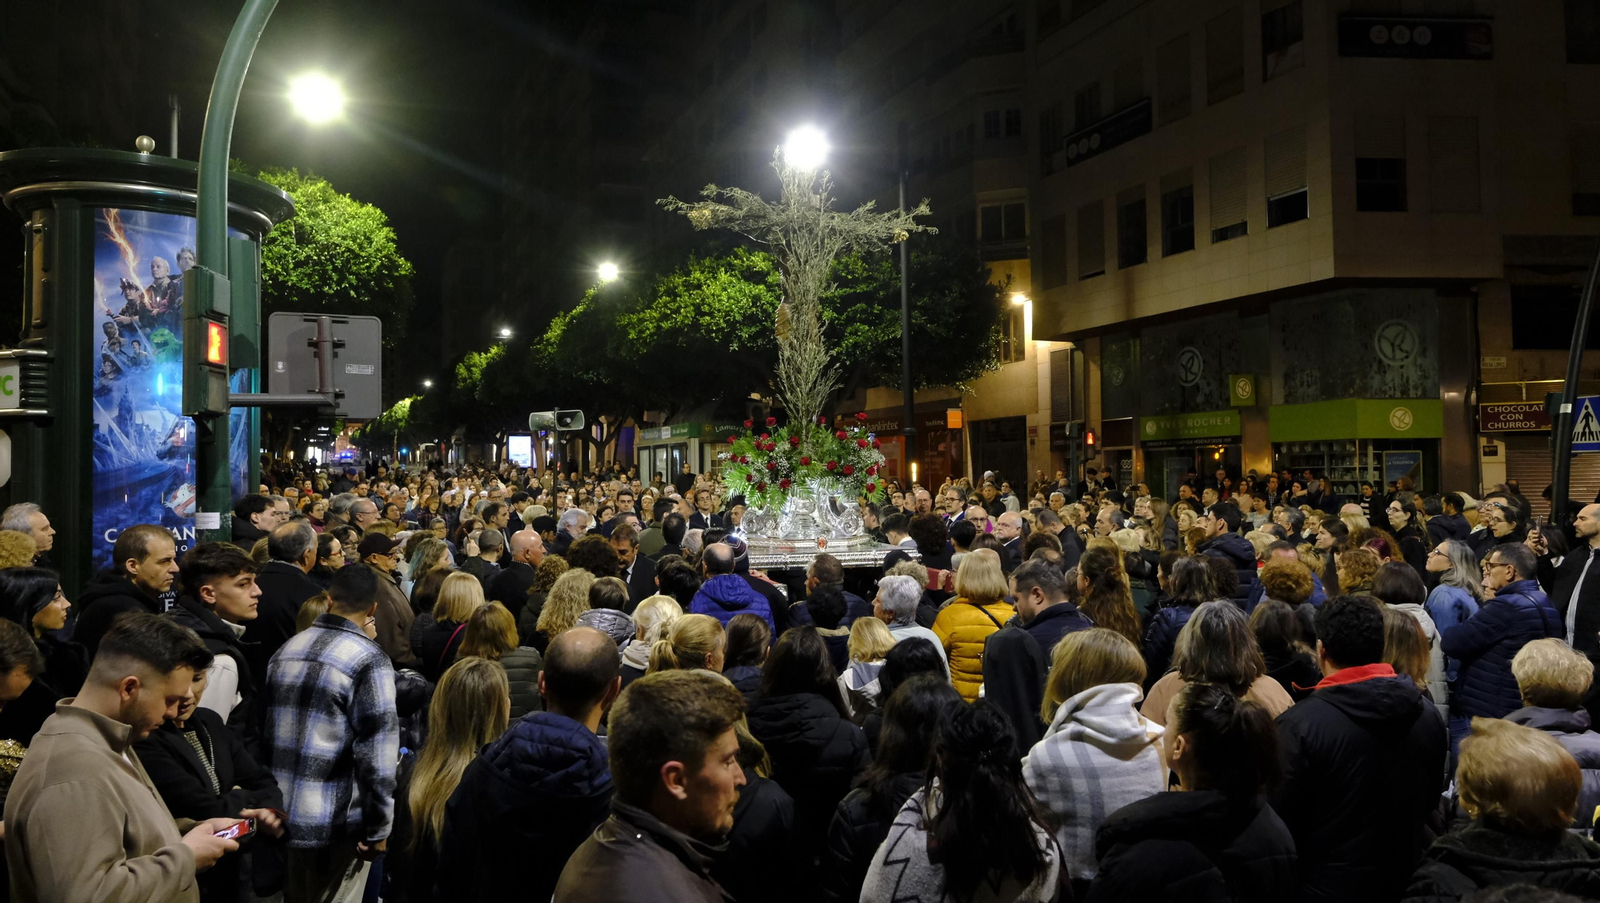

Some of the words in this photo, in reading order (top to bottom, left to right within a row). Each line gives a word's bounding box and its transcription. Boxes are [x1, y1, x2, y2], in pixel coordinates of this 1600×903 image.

[1487, 404, 1544, 413] CHOCOLAT
[1500, 413, 1523, 421] CON
[1160, 420, 1184, 429] YVES
[1187, 416, 1231, 427] ROCHER
[1487, 421, 1536, 429] CHURROS
